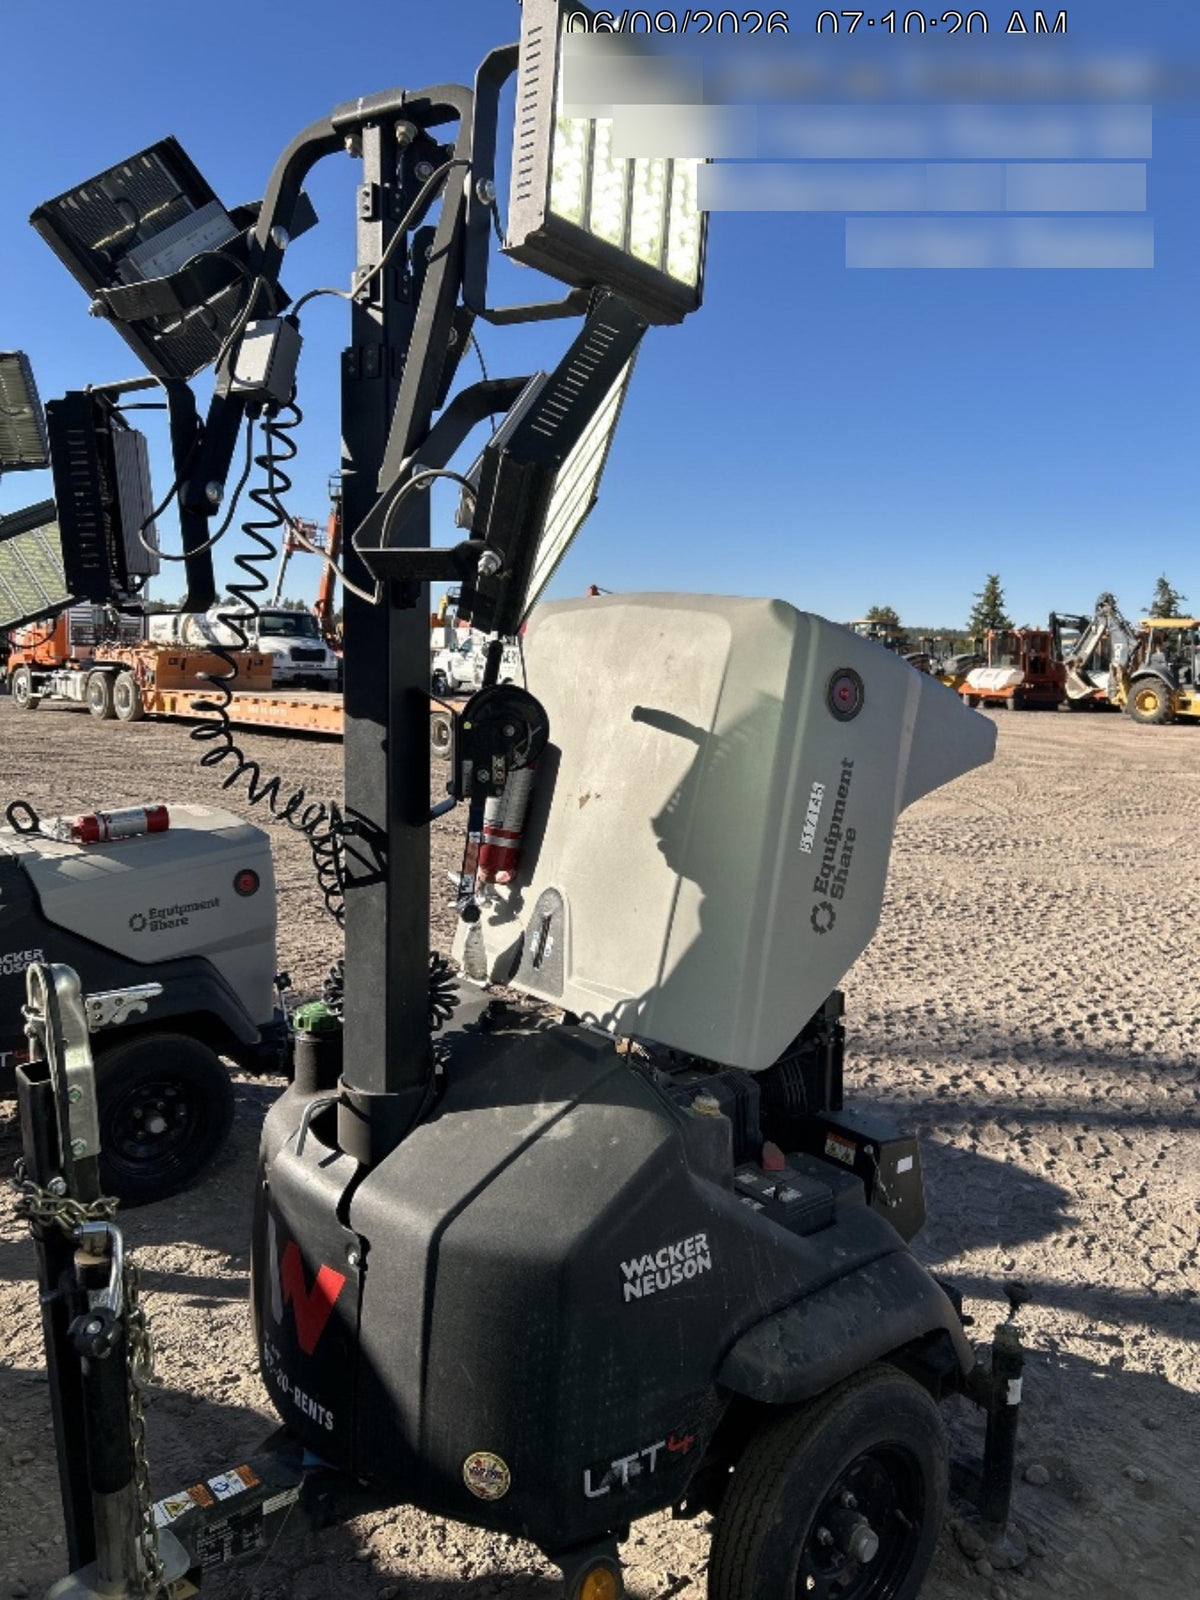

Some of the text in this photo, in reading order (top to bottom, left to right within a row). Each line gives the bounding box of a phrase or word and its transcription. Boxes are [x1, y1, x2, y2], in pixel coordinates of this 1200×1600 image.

[813, 757, 854, 895] Equipment
[830, 828, 857, 900] Share
[149, 897, 220, 919] Equipment
[150, 917, 189, 932] Share
[0, 949, 45, 964] CKER
[620, 1233, 708, 1280] WACKER
[623, 1251, 712, 1302] NEUSON
